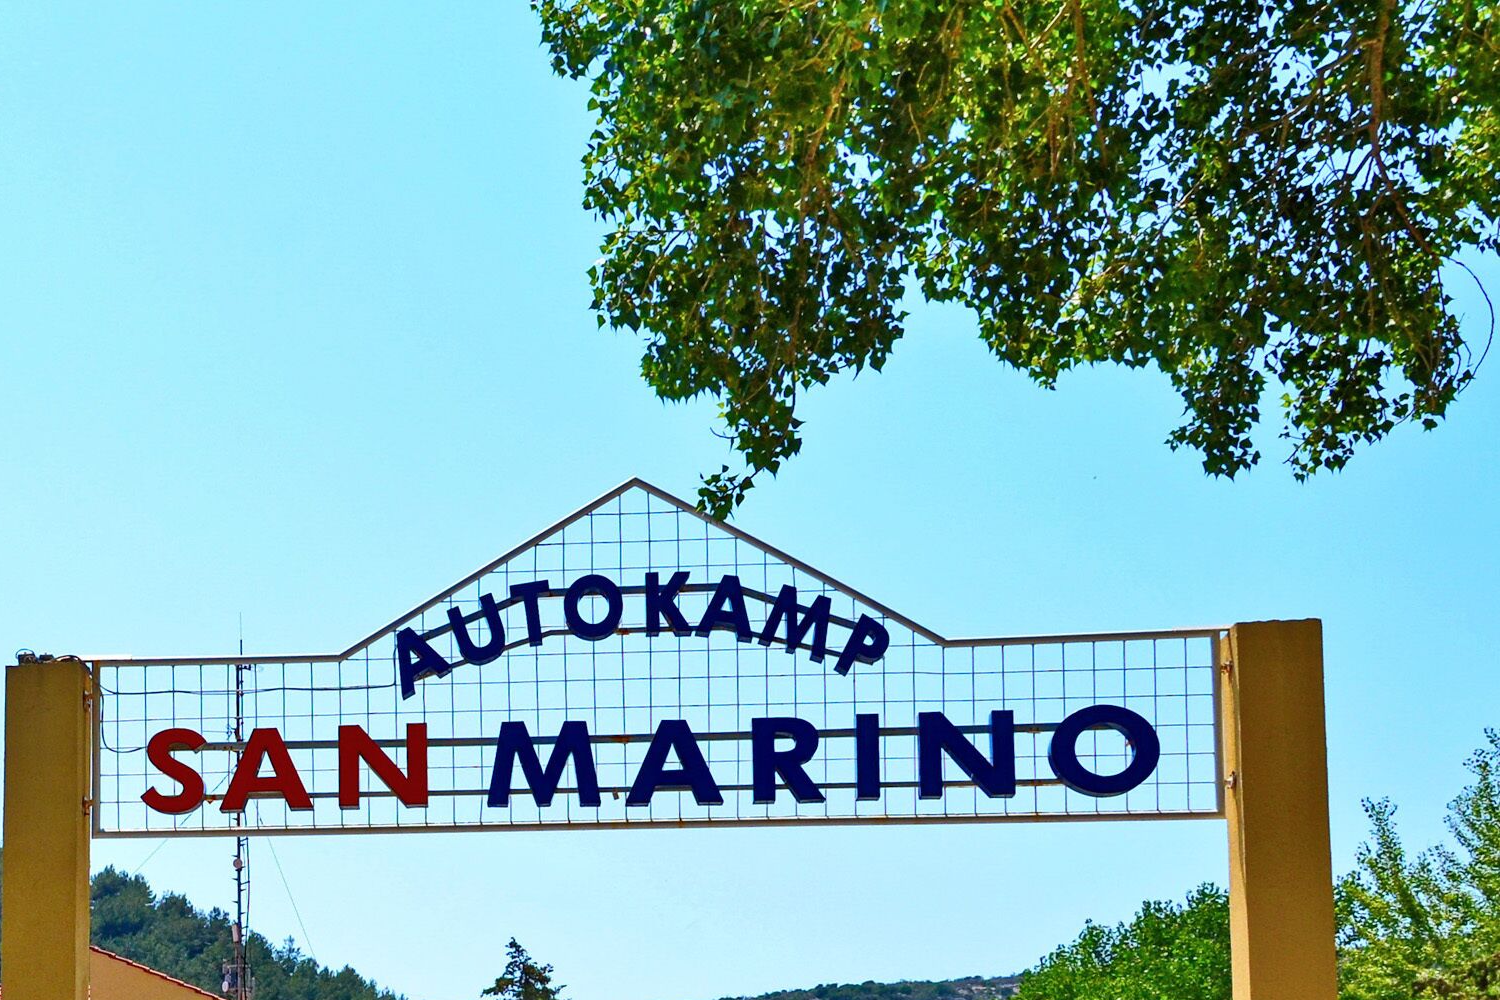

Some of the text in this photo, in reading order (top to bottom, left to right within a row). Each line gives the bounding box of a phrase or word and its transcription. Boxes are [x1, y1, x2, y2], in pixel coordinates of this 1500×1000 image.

[394, 570, 891, 701] AUTOKAMP
[140, 704, 1161, 815] SAN MARINO
